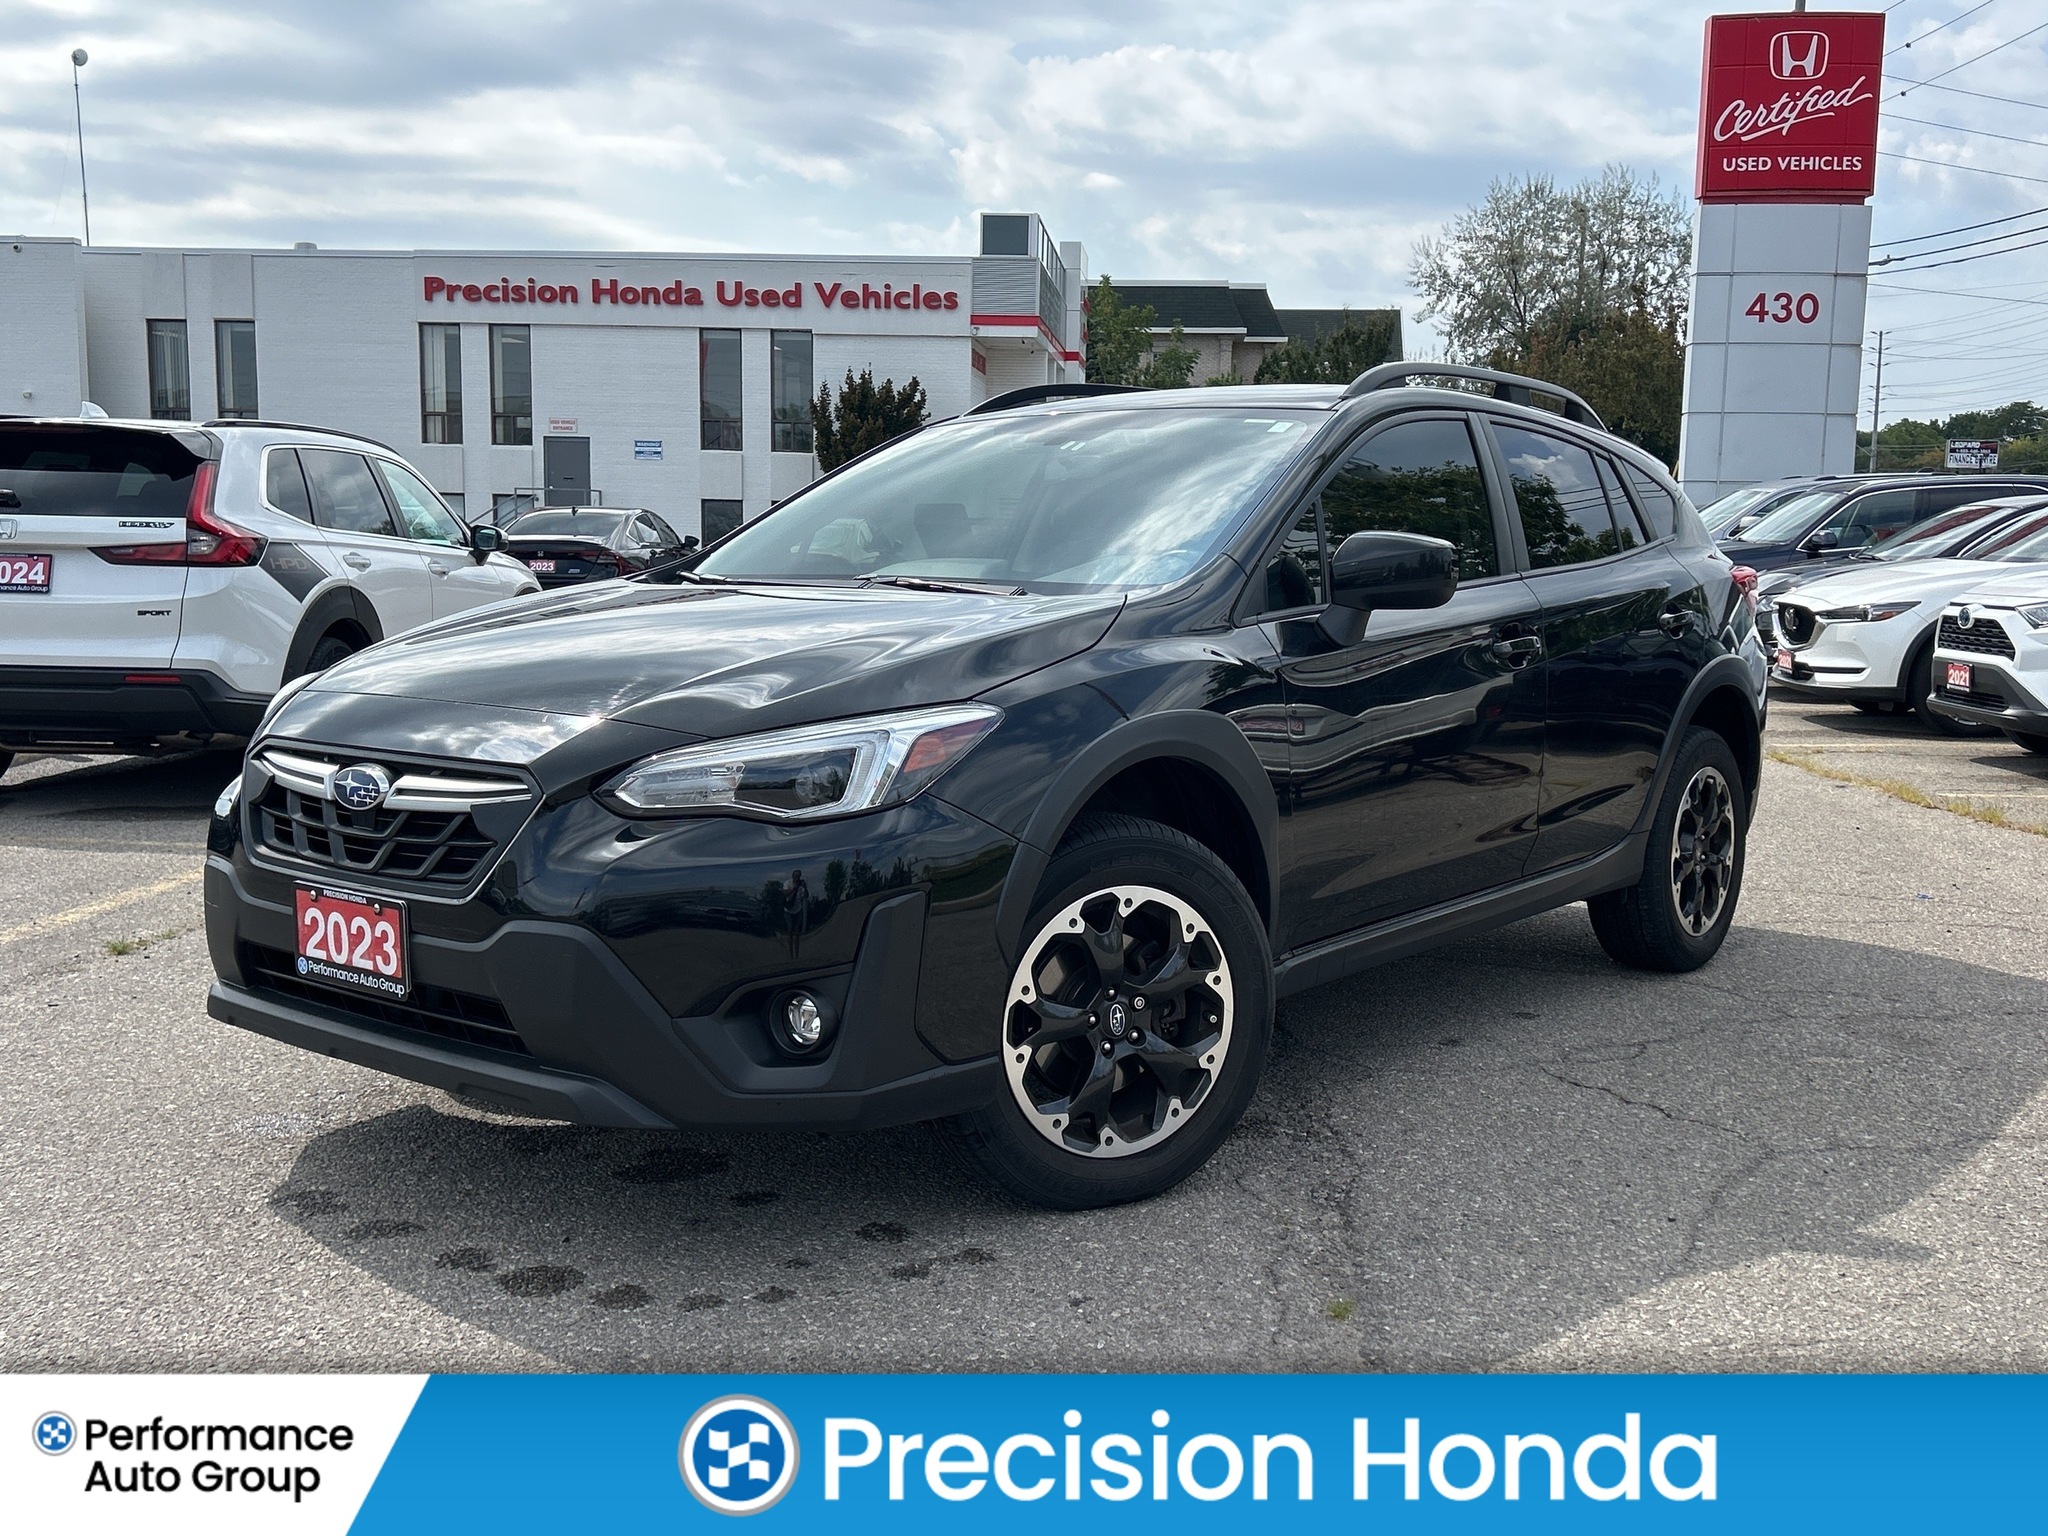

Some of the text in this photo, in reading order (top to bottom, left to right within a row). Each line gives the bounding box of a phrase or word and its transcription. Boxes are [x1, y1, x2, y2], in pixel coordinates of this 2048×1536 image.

[1714, 75, 1873, 141] Certified
[1722, 156, 1863, 171] USED VEHICLES
[423, 276, 958, 310] Precision Honda Used Vehicles
[1745, 292, 1819, 323] 430
[1949, 454, 1973, 464] FINANCE
[269, 557, 308, 570] HPD
[530, 562, 555, 571] 2023
[1948, 669, 1970, 687] 2021
[323, 889, 367, 905] PRECISION HONDA
[304, 907, 398, 976] 2023
[308, 960, 405, 998] Performance Auto Group
